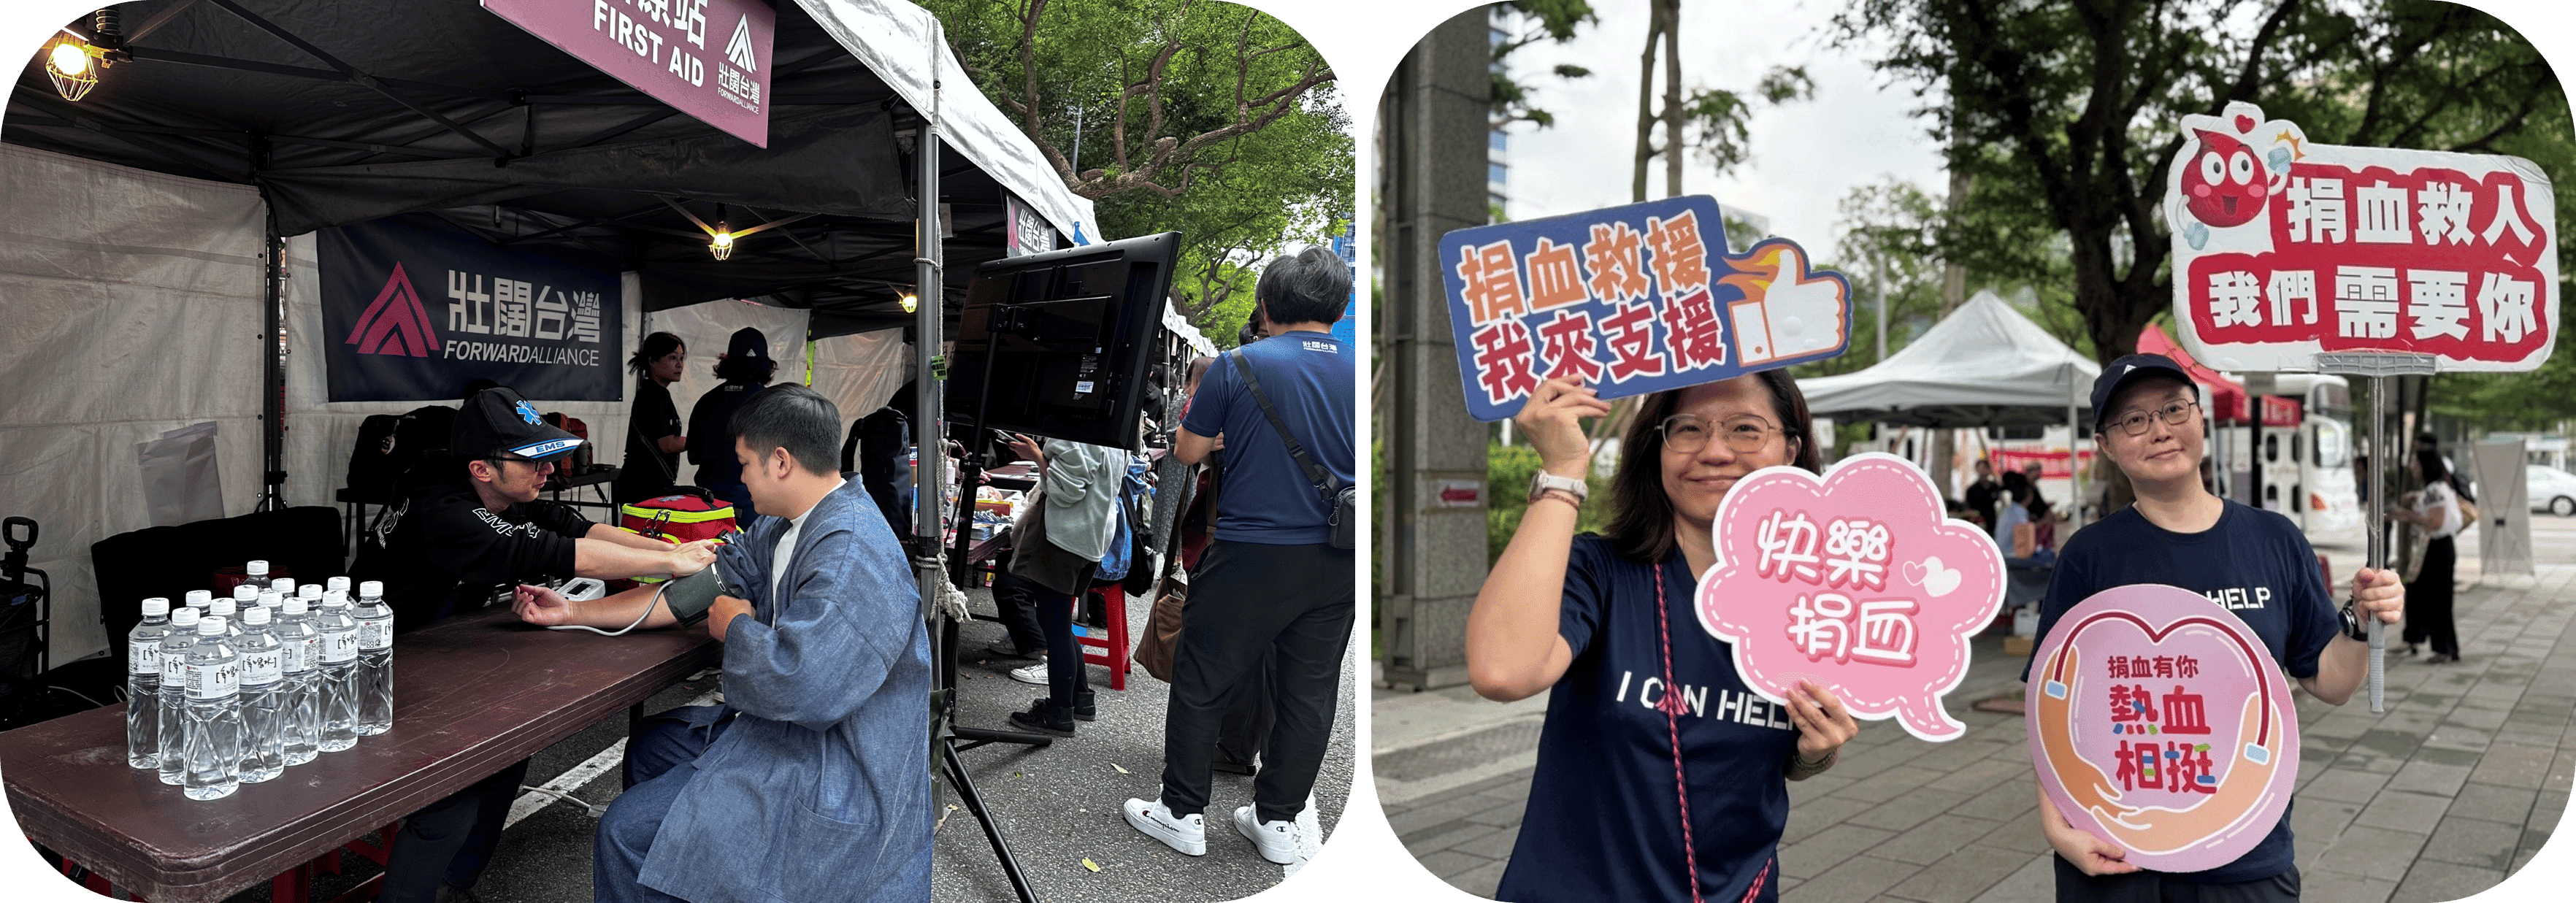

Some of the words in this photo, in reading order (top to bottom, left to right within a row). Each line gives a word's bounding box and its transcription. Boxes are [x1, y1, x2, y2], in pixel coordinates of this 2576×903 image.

[594, 0, 663, 64] FIRST
[668, 45, 704, 88] AID
[718, 61, 760, 104] 壯闊台灣
[718, 86, 759, 115] FORWARDALLIANCE
[2286, 176, 2536, 247] 捐血救人
[1457, 210, 1711, 326] 捐血救援
[448, 269, 600, 342] 壯闊台灣
[2208, 265, 2537, 344] 我們需要你
[443, 339, 599, 366] FORWARDALLIANCE
[1471, 290, 1725, 405] 我來支援
[535, 441, 566, 453] EMS
[1756, 509, 1891, 588] 快樂
[1787, 592, 1917, 664] 捐血
[2206, 586, 2271, 610] HELP
[2107, 655, 2199, 679] 捐血有你
[1617, 670, 1633, 703] I
[1716, 689, 1793, 731] HEL
[2109, 684, 2212, 735] 熱血
[2115, 739, 2218, 795] 相挺
